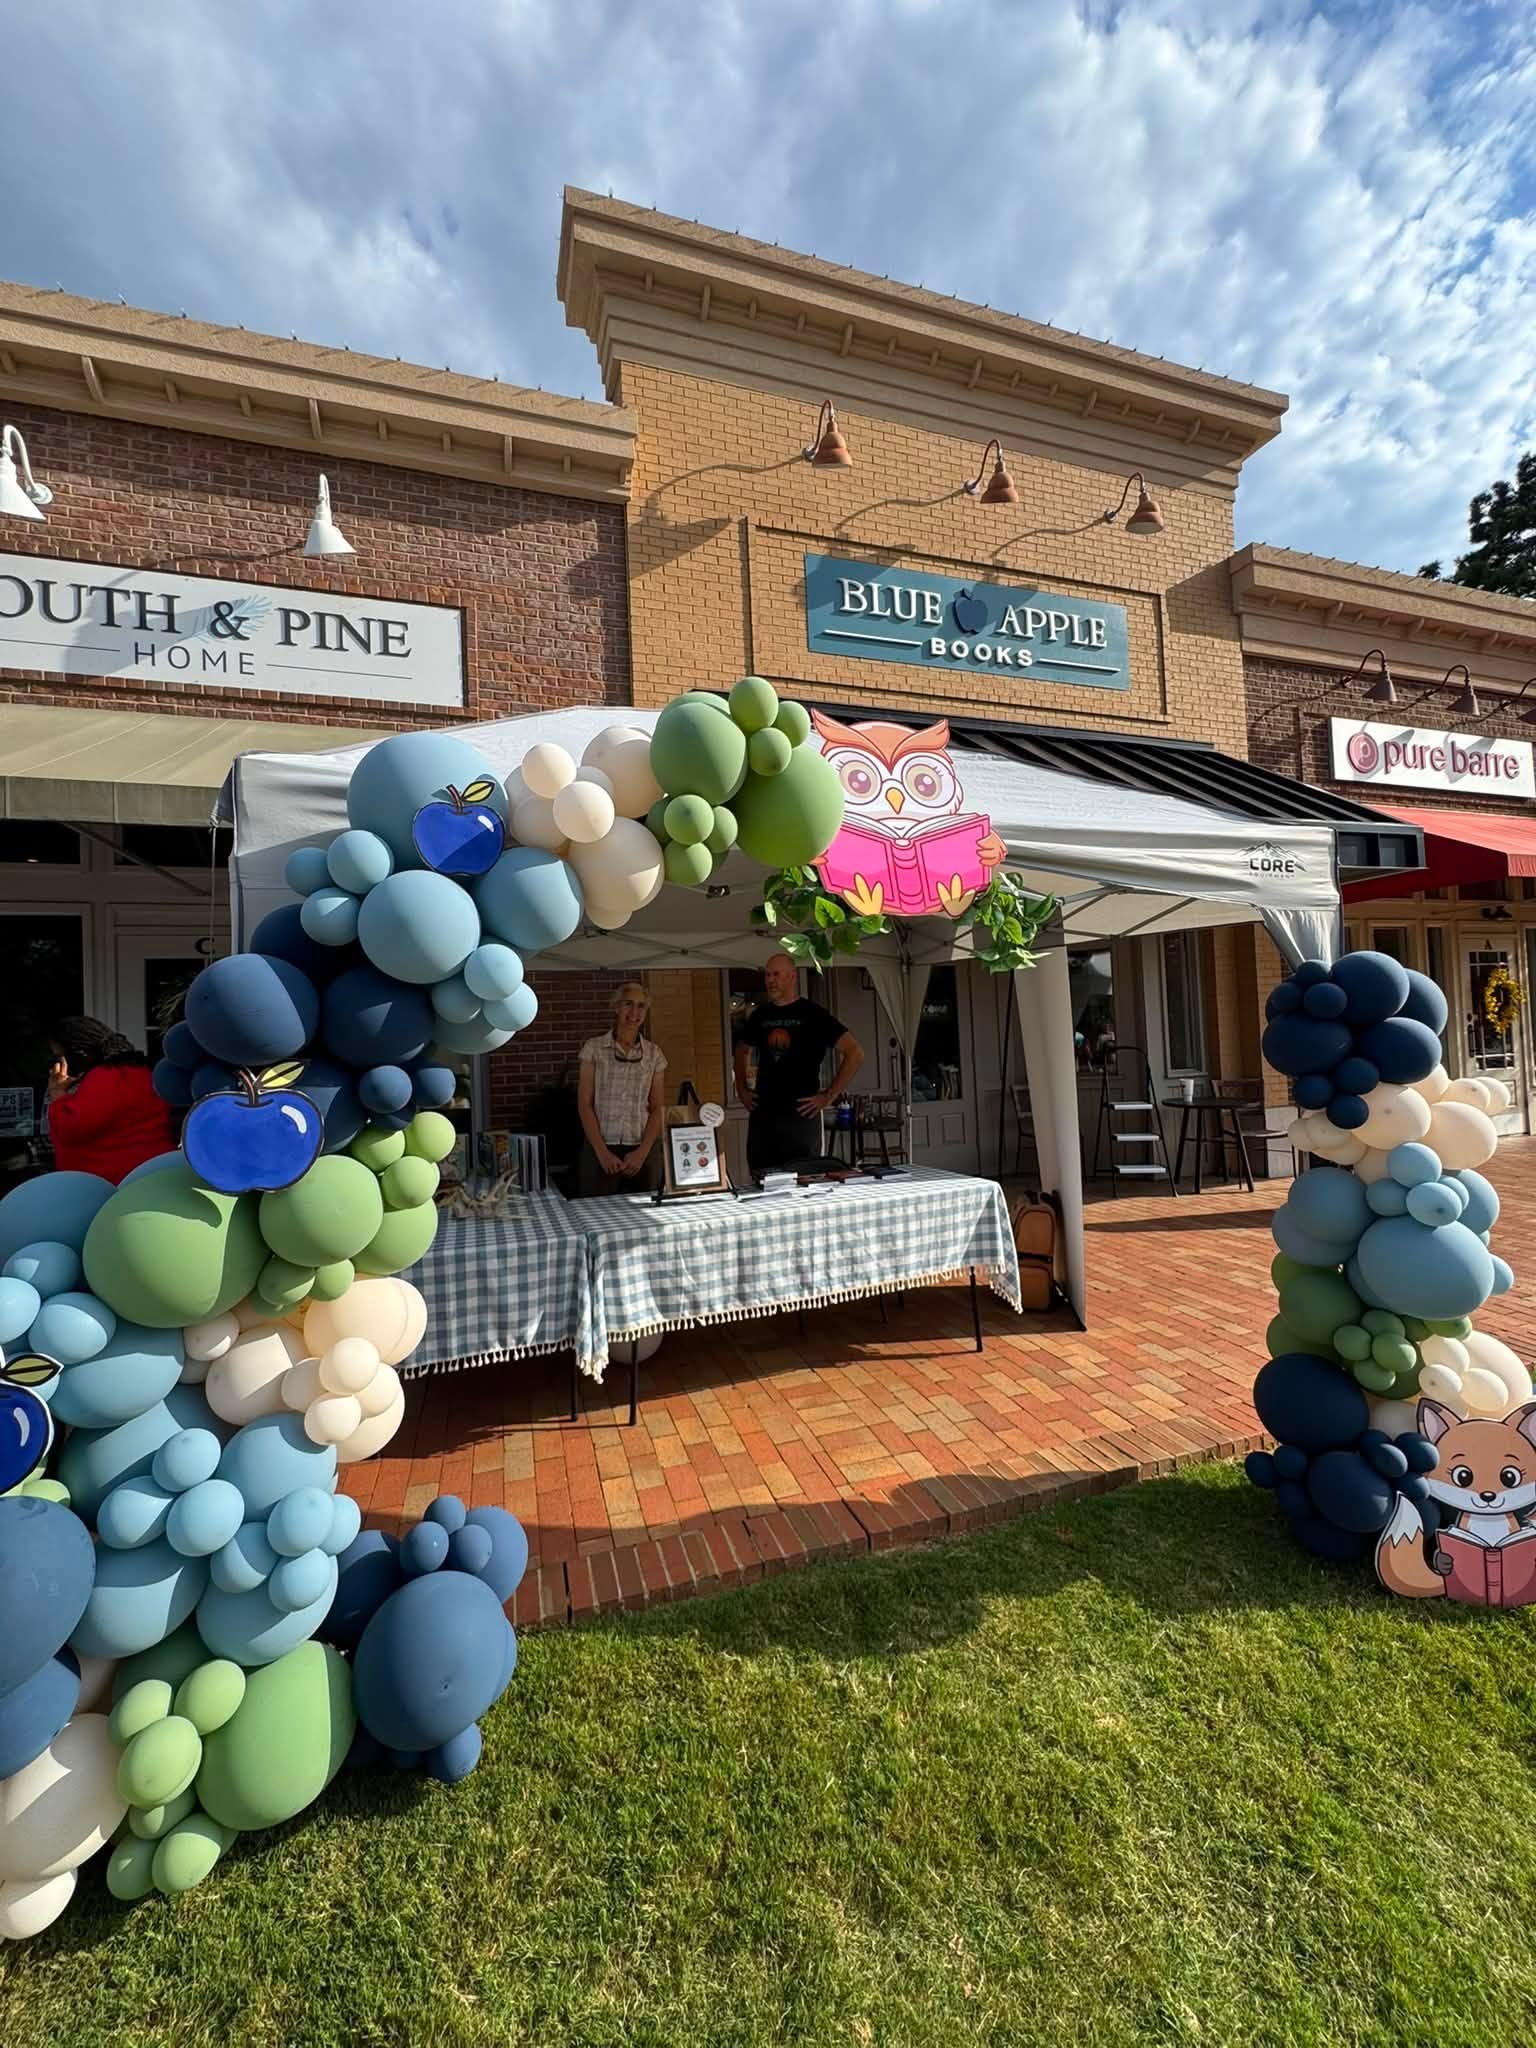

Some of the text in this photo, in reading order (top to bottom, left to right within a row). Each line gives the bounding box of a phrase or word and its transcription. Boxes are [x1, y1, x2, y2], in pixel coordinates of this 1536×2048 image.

[209, 600, 251, 641] &
[274, 607, 413, 658] PINE
[837, 578, 1109, 649] BLUE APPLE
[134, 641, 256, 676] HOME
[929, 637, 1034, 667] BOOKS
[1384, 740, 1521, 780] pure barre
[1249, 857, 1295, 873] CORE
